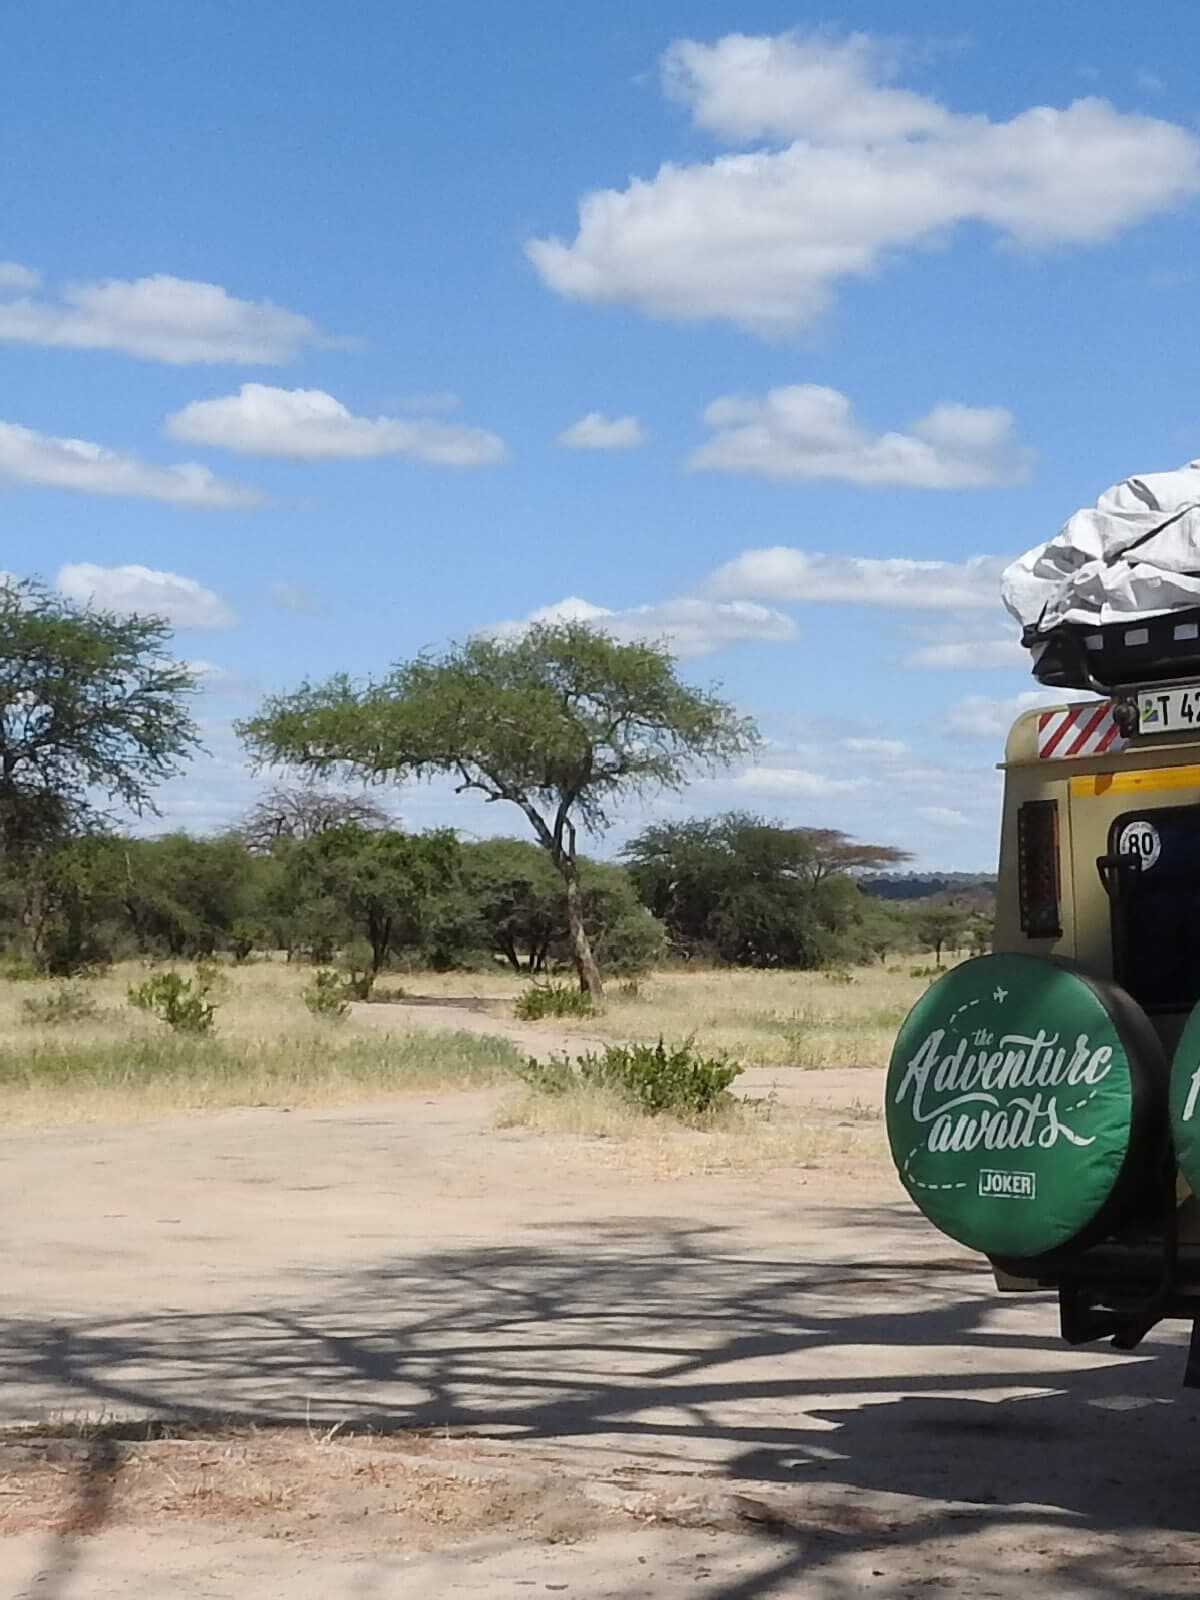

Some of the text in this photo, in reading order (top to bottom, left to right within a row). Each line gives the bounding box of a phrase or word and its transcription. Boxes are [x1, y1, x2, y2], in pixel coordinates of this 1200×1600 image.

[1157, 695, 1170, 726] T
[1128, 832, 1154, 856] 80
[972, 1028, 994, 1046] the
[895, 1029, 1113, 1122] Adventure
[927, 1092, 1096, 1152] awaits
[982, 1173, 1032, 1194] JOKER
